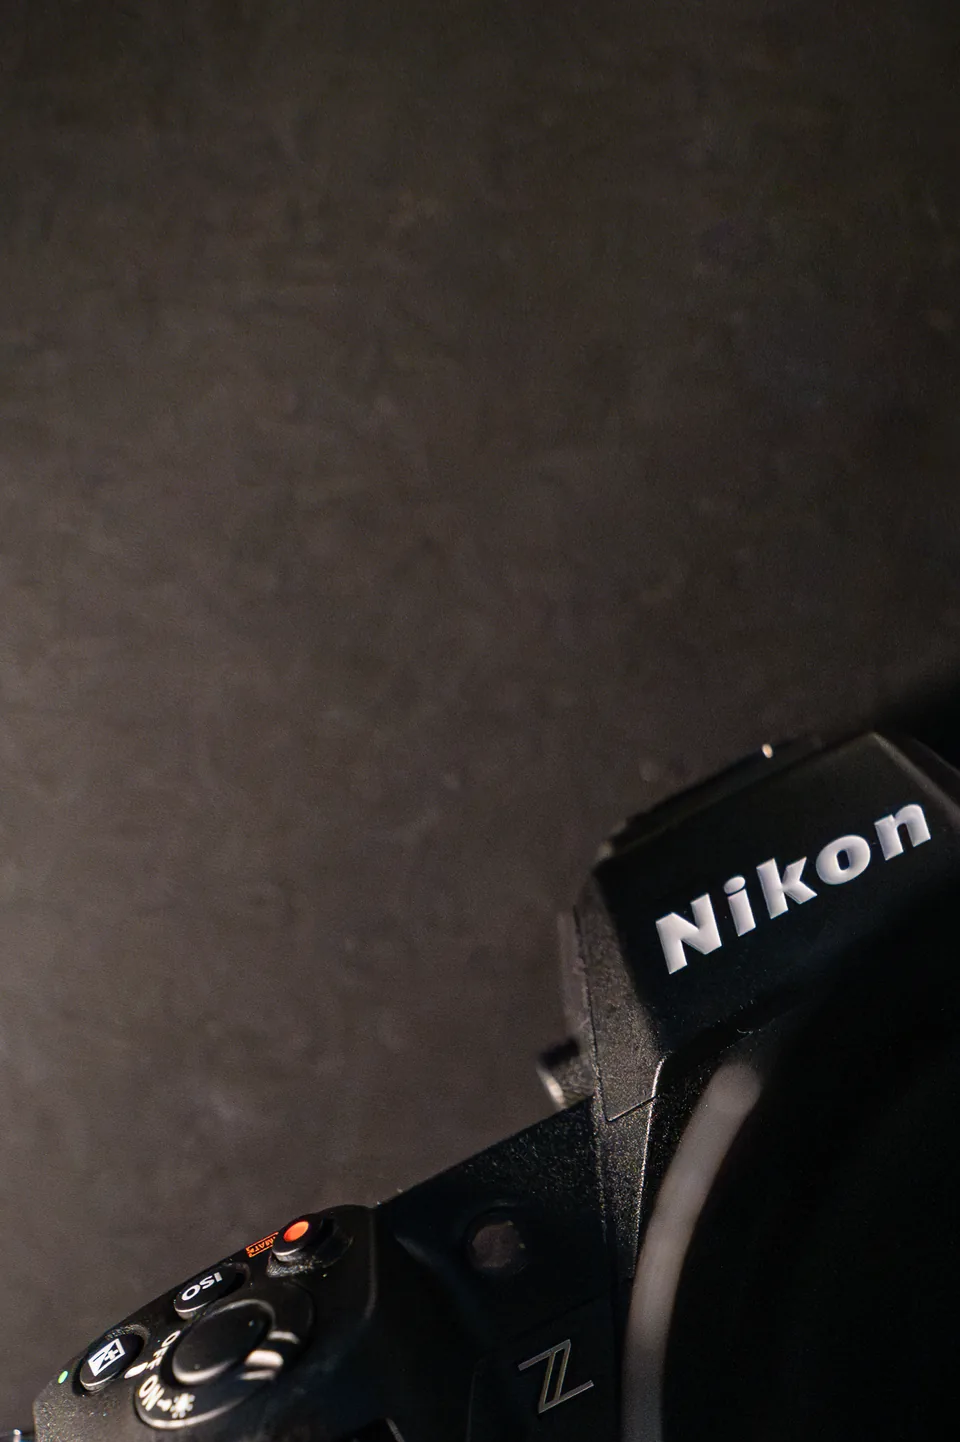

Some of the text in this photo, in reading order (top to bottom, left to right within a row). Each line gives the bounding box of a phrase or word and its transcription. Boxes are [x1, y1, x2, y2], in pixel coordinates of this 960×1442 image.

[655, 803, 931, 974] Nikon
[181, 1271, 223, 1301] ISO
[517, 1339, 595, 1414] Z
